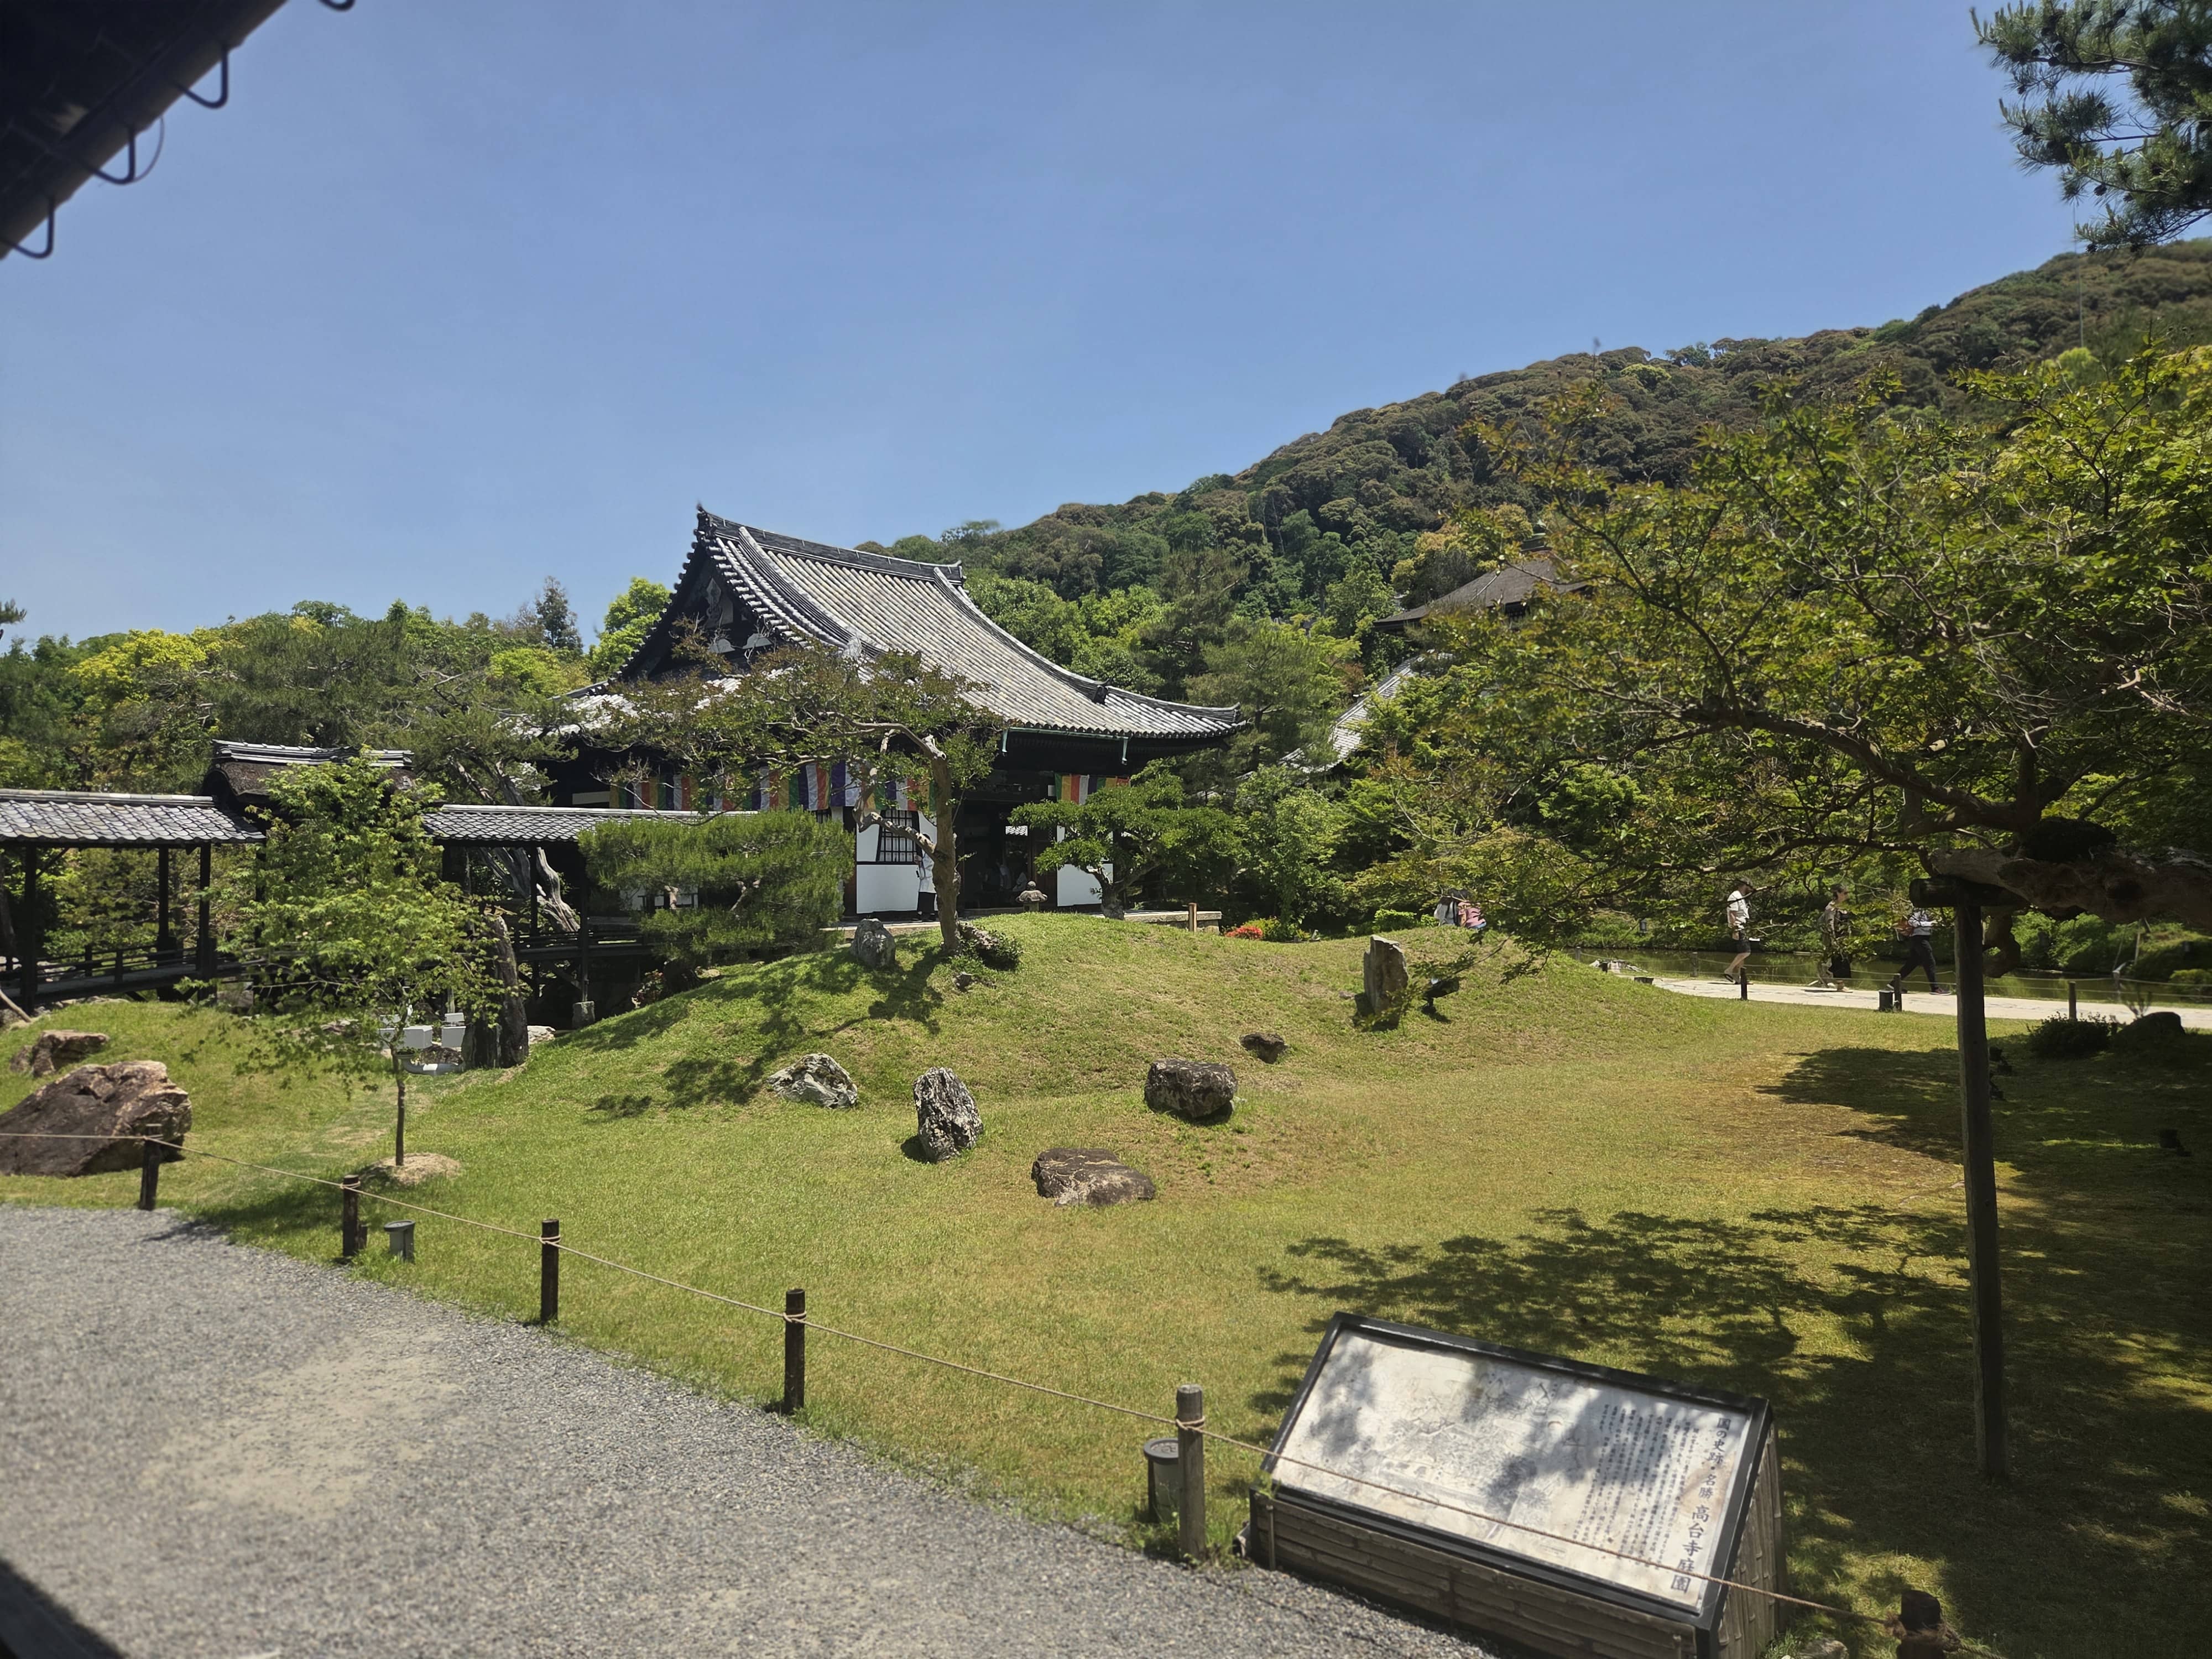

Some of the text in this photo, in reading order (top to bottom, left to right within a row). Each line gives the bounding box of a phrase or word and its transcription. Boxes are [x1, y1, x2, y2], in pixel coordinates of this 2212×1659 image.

[1671, 1418, 1731, 1593] 国の史跡・名勝 高台寺庭園
